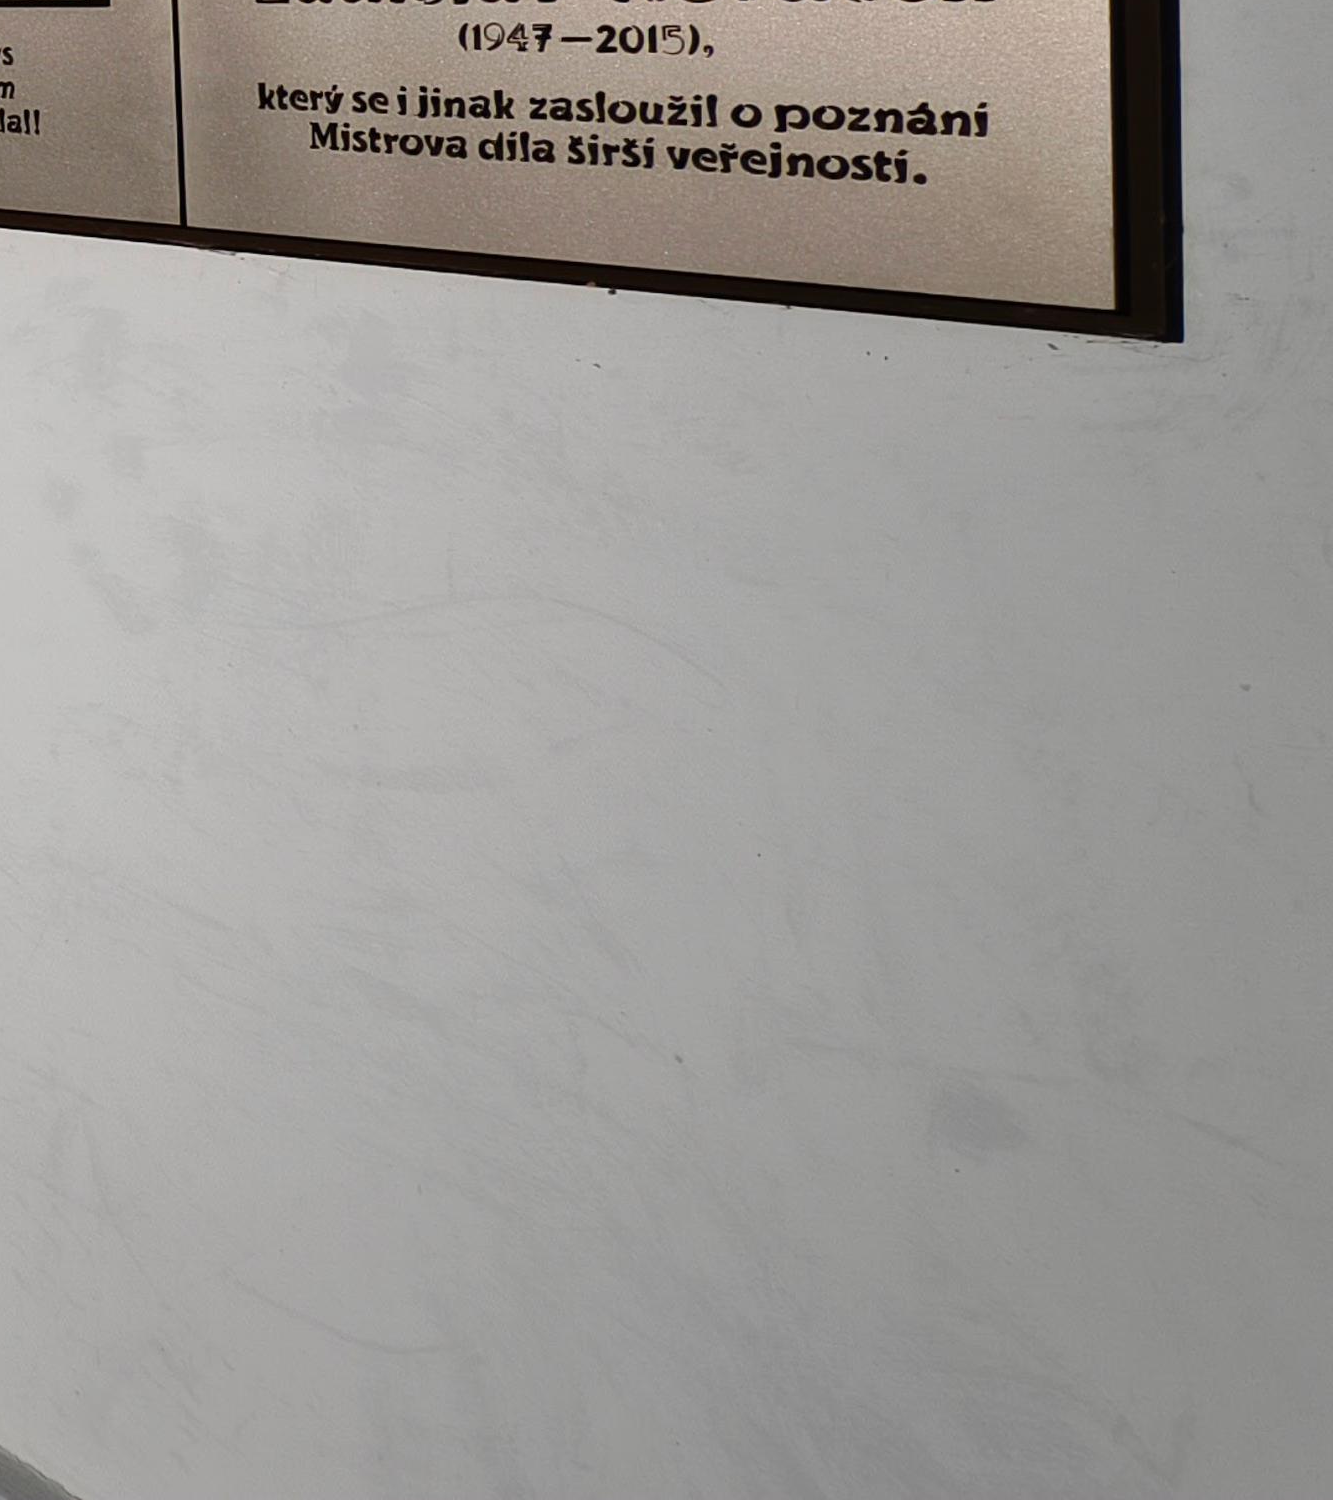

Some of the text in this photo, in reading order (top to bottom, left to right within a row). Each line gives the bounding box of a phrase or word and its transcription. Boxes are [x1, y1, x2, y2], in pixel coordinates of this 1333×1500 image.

[257, 82, 989, 138] který se i jinak zasloužil o poznání
[309, 121, 928, 185] Mistrova díla širší veřejnosti.
